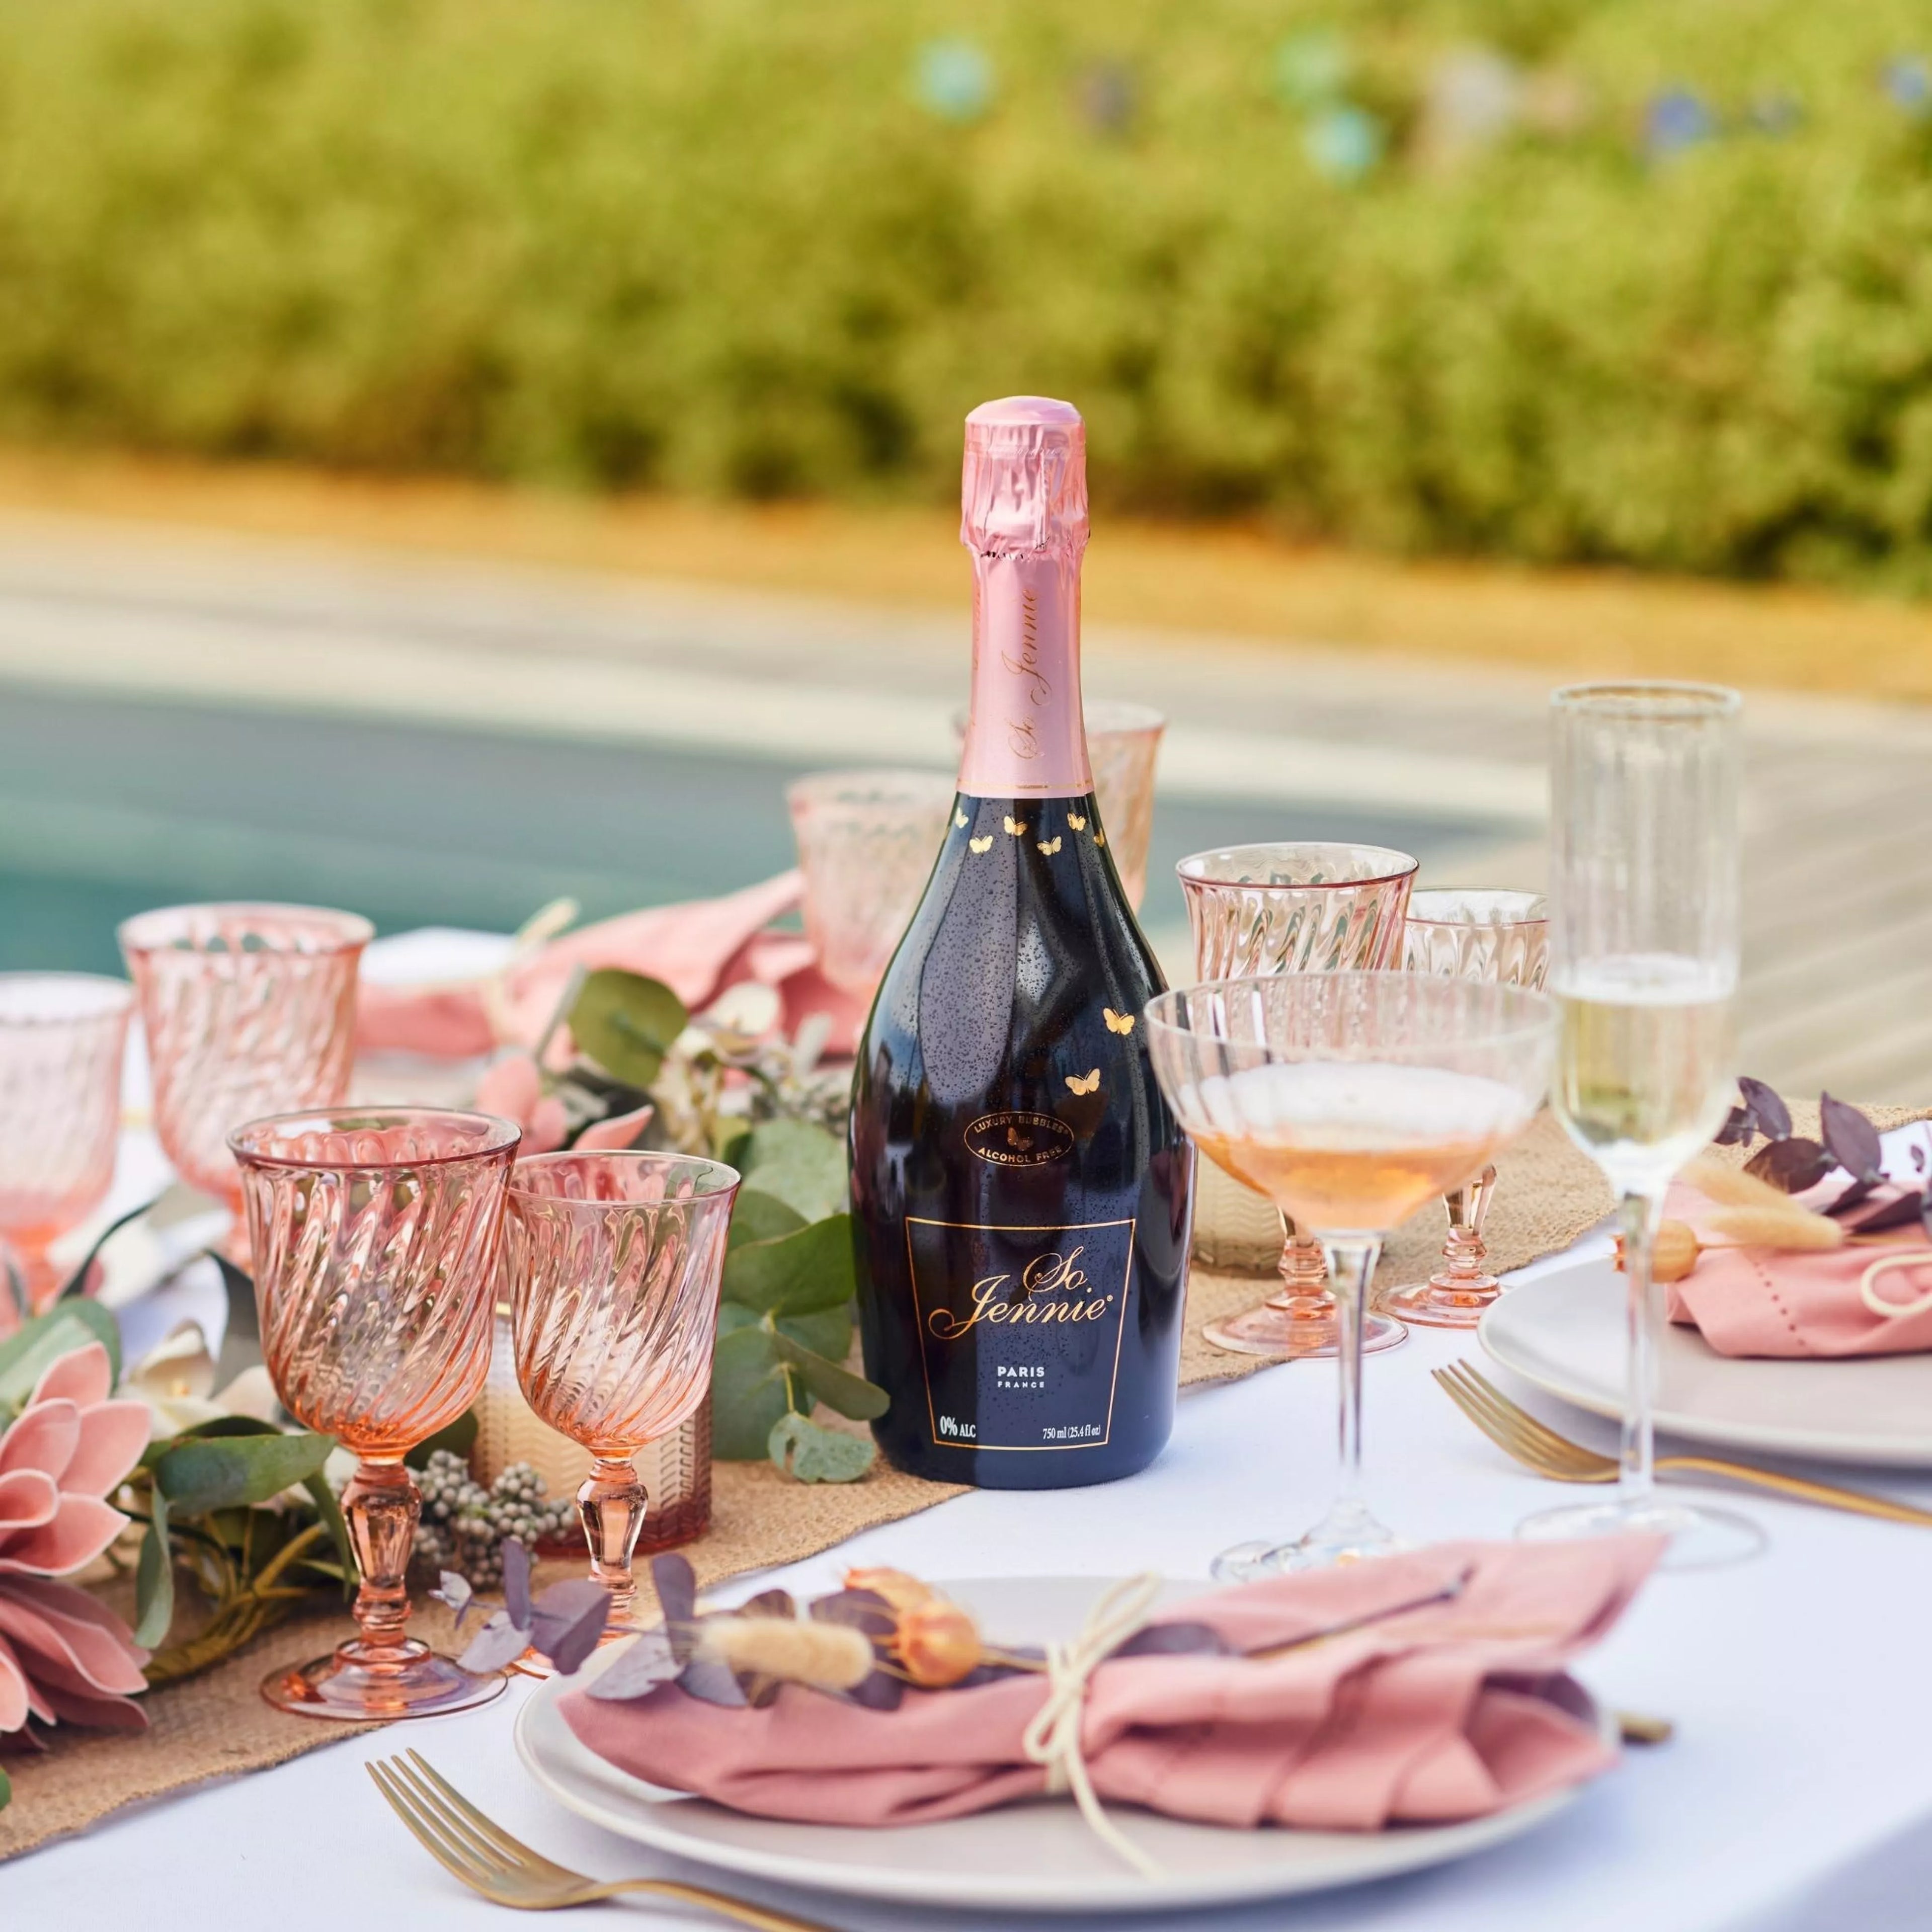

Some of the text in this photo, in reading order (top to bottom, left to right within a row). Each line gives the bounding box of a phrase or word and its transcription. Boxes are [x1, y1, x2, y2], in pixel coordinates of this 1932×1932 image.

[1001, 589, 1052, 706] Jennie
[974, 1115, 1013, 1133] LUXURY
[978, 1146, 1062, 1163] ALCOHOL FREE
[1023, 1246, 1088, 1302] So
[997, 1366, 1045, 1378] PARIS
[940, 1415, 976, 1438] 0% ALC
[1042, 1427, 1056, 1439] 750
[1057, 1426, 1067, 1438] ml
[1068, 1425, 1084, 1438] (25.4
[1085, 1424, 1091, 1436] fl
